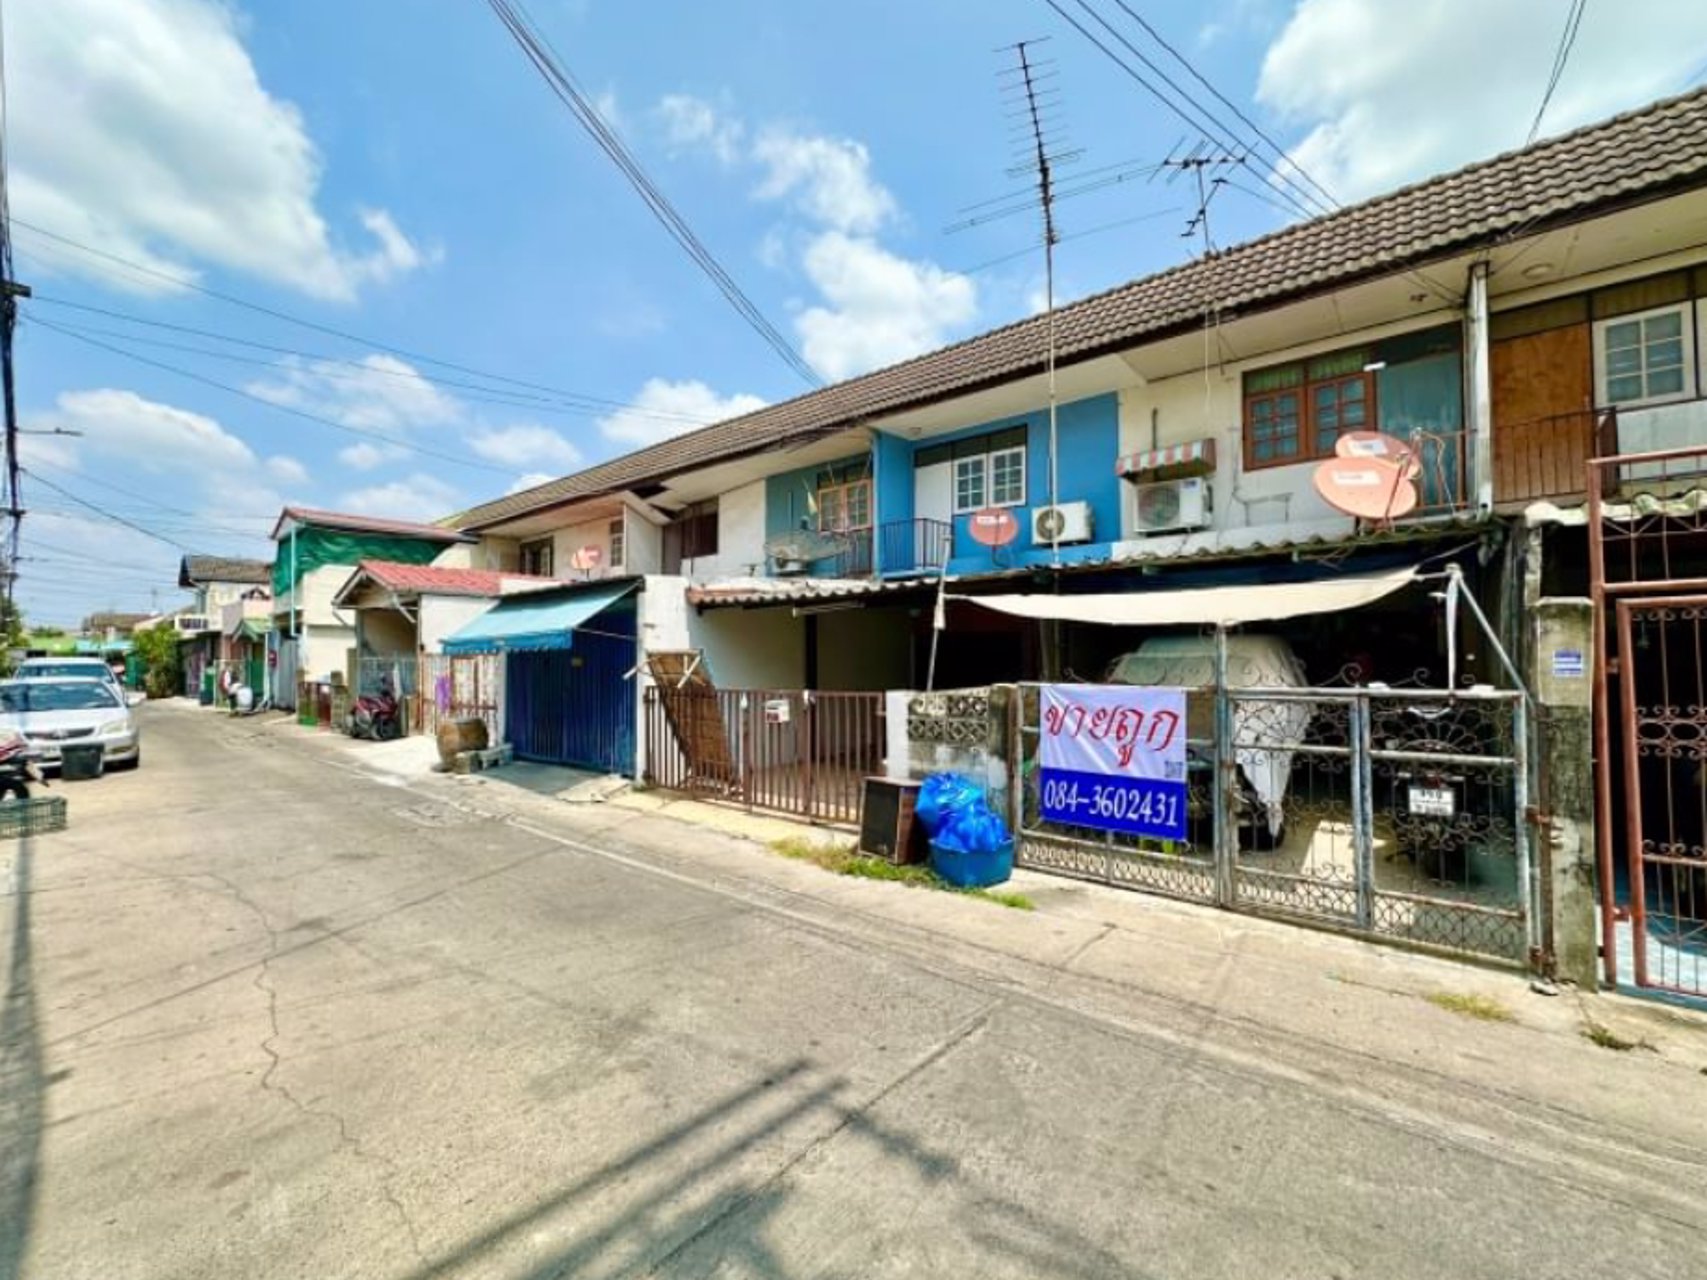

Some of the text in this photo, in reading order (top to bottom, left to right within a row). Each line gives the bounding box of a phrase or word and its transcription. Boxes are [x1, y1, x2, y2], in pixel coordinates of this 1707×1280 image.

[1045, 704, 1180, 768] ขายถูก
[1043, 779, 1178, 827] 084-3602431
